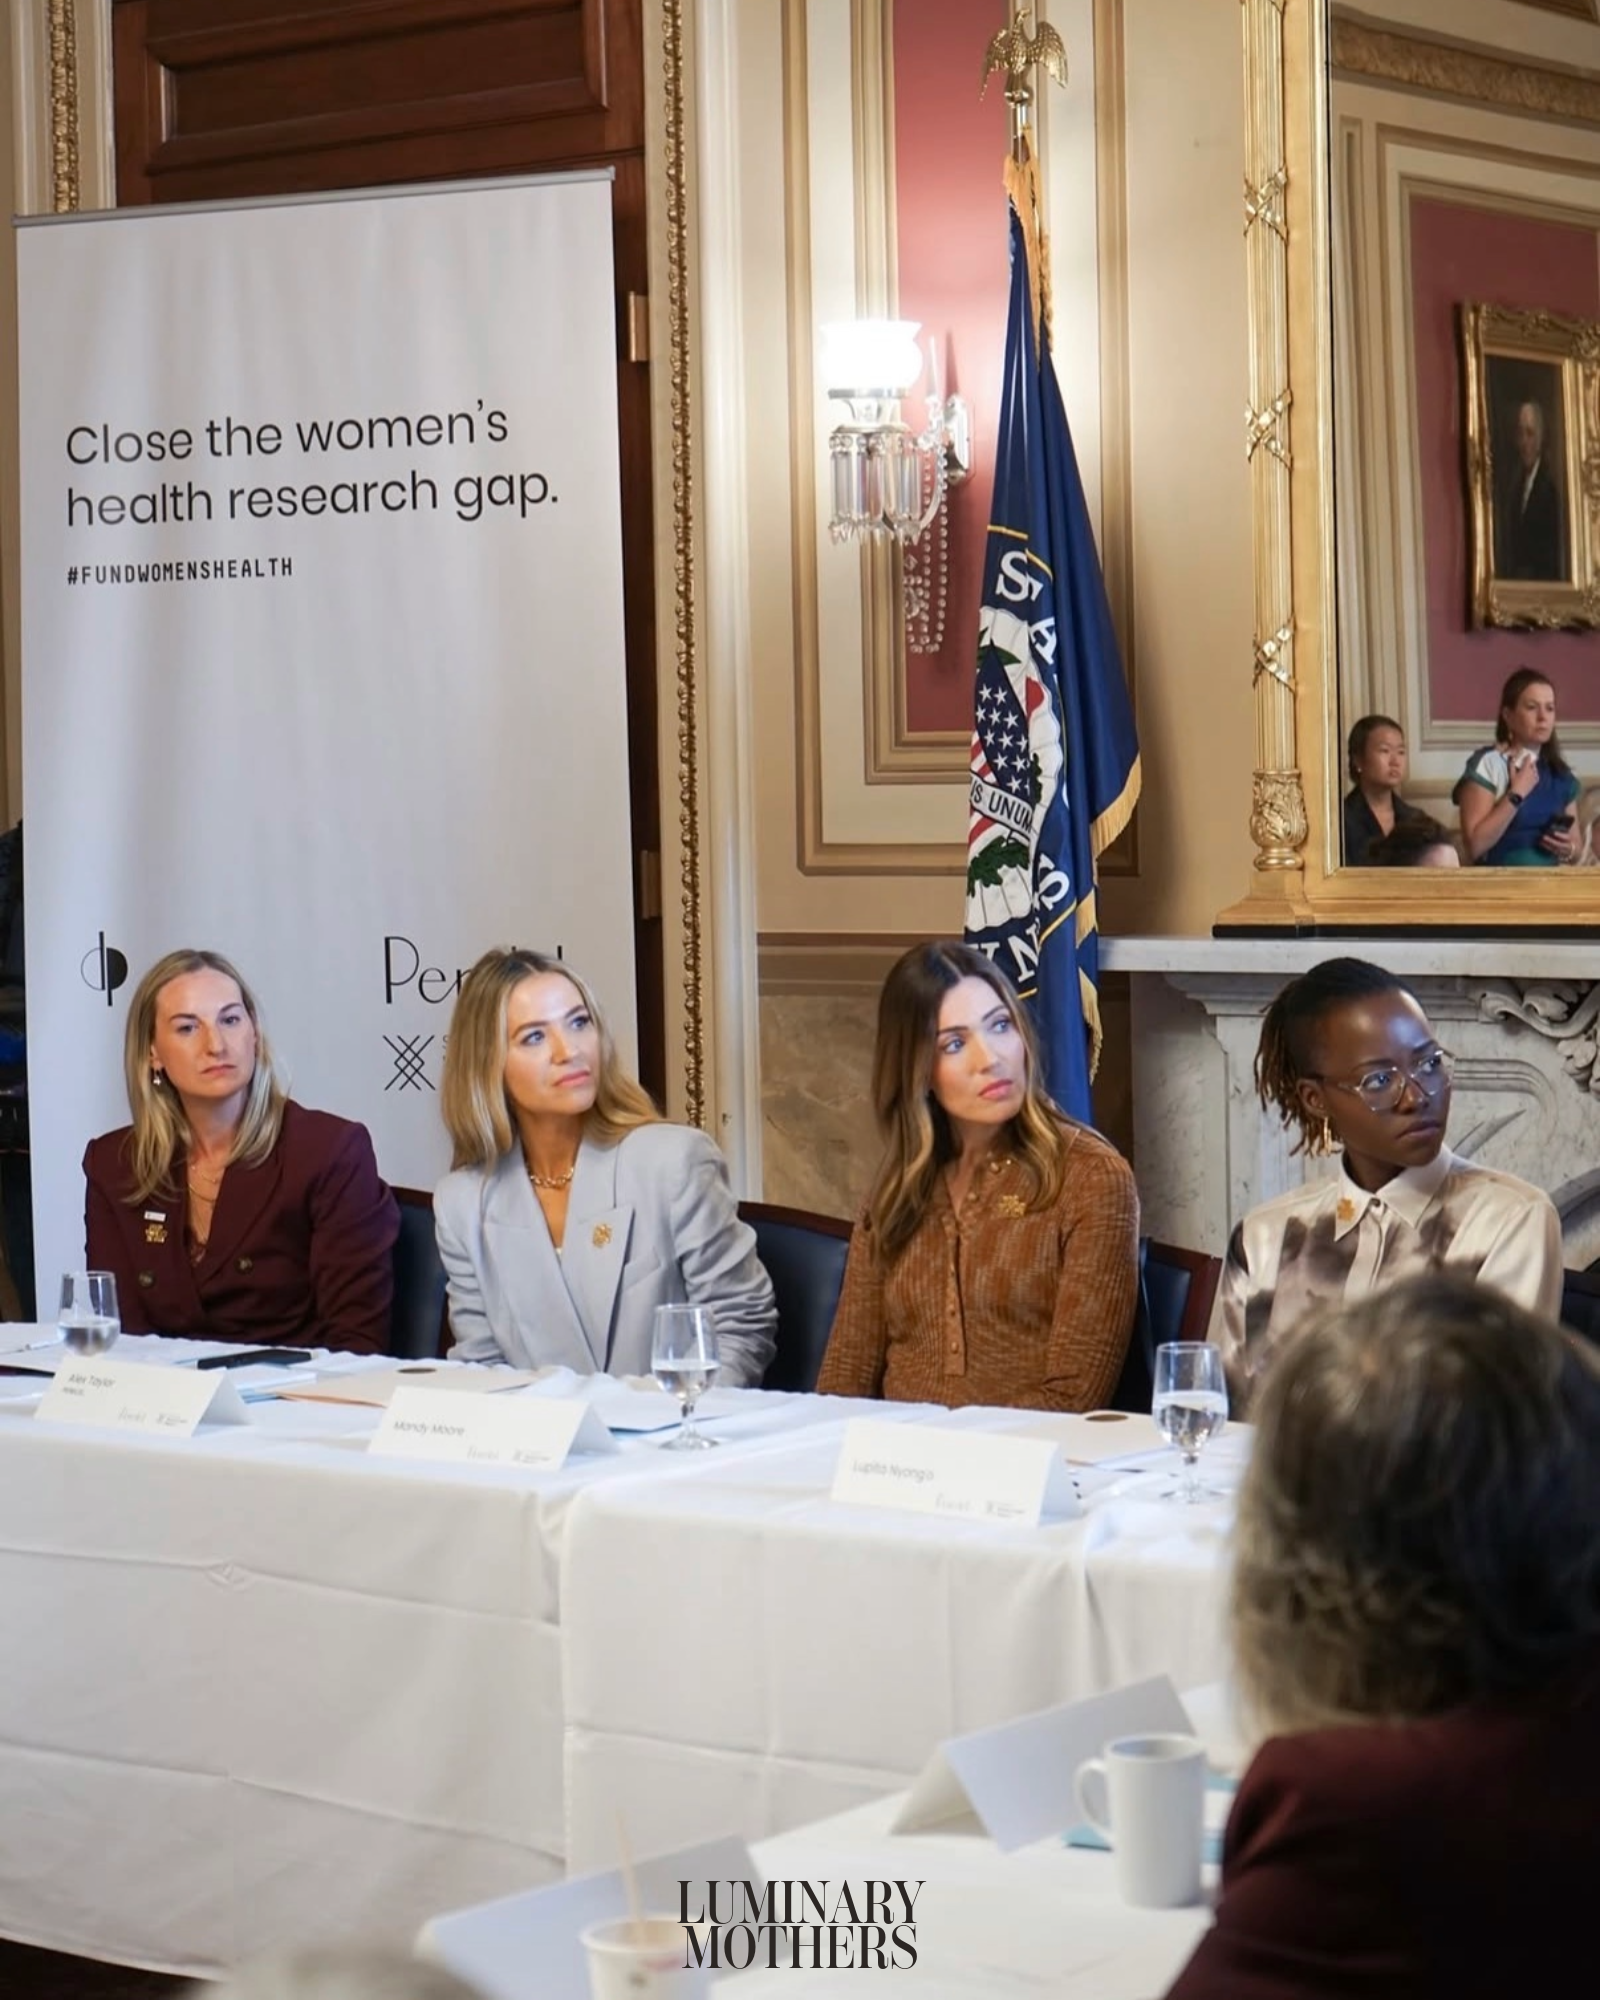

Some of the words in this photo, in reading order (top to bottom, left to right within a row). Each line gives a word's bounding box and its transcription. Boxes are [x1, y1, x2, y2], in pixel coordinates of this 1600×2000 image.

[66, 425, 193, 465] Close
[206, 416, 282, 458] the
[296, 398, 508, 453] women's
[67, 483, 212, 527] health
[228, 470, 437, 520] research
[453, 472, 559, 521] gap.
[67, 557, 294, 585] #FUNDWOMENSHEALTH
[431, 1423, 465, 1437] Moore
